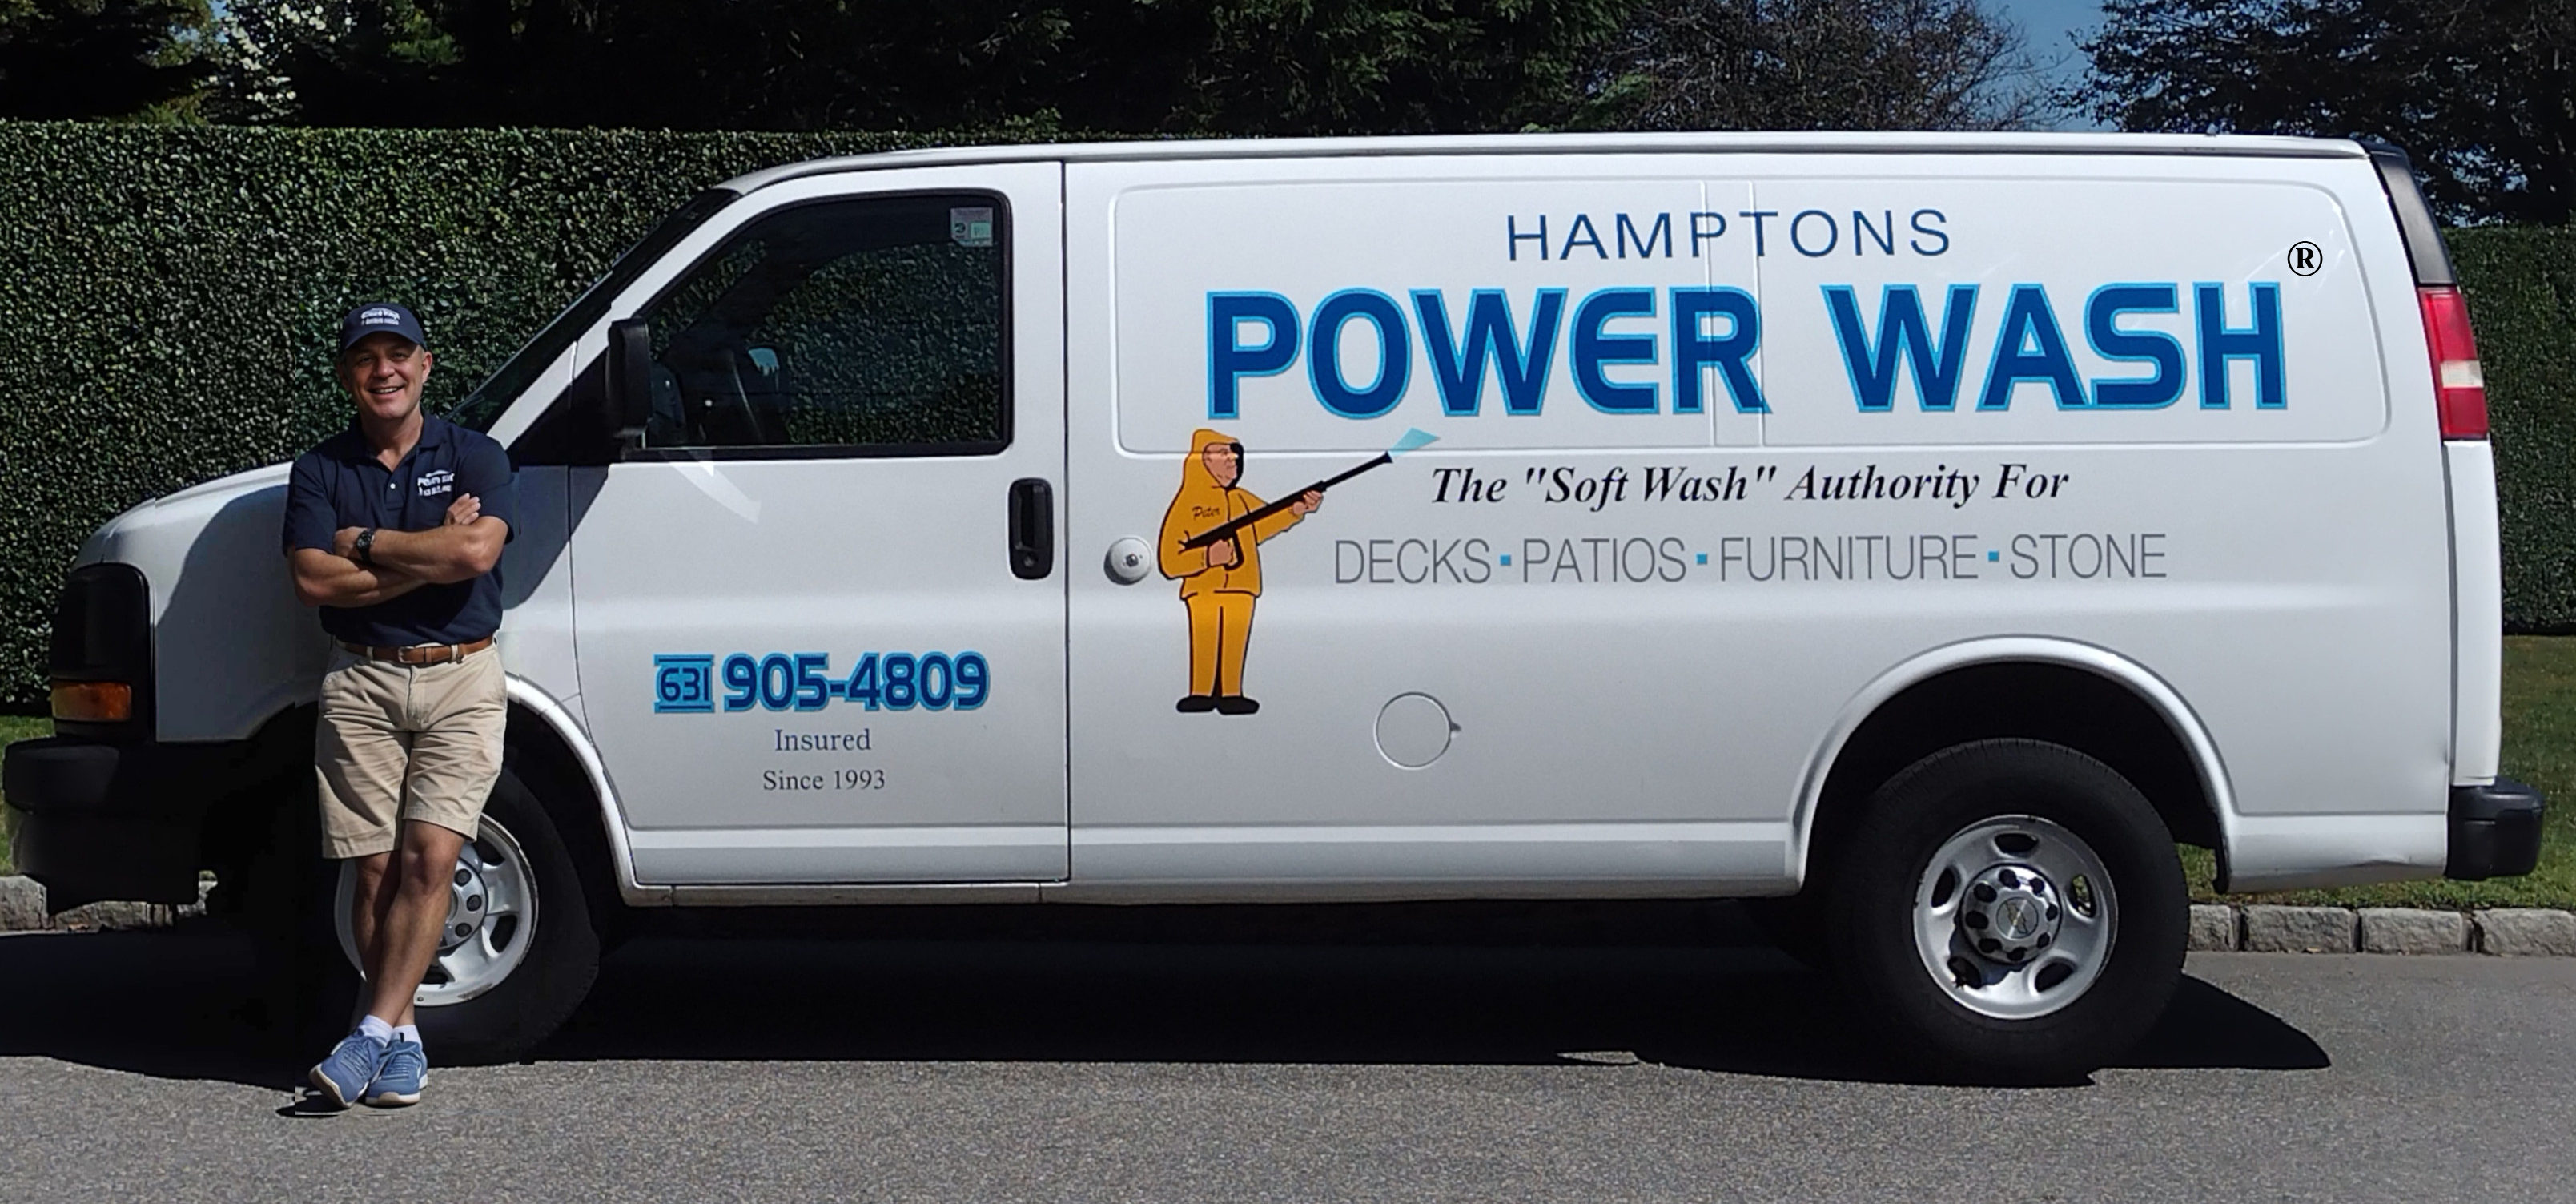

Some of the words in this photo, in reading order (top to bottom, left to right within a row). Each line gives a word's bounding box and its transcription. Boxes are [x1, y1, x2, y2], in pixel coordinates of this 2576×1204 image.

[1507, 209, 1951, 261] HAMPTONS
[1206, 285, 1773, 421] POWER
[1819, 281, 2289, 413] WASH
[1430, 467, 1508, 504] The
[1525, 465, 1630, 513] "Soft
[1642, 464, 1778, 503] Wash"
[1783, 464, 1980, 509] Authority
[1991, 463, 2070, 500] For
[1334, 538, 1492, 584] DECKS
[1522, 536, 1687, 583] PATIOS
[1720, 534, 1979, 582] FURNITURE
[2009, 533, 2168, 580] STONE
[656, 658, 713, 708] 631
[721, 650, 991, 712] 905-4809
[774, 728, 872, 751] Insured
[762, 770, 824, 791] Since
[834, 769, 886, 791] 1993
